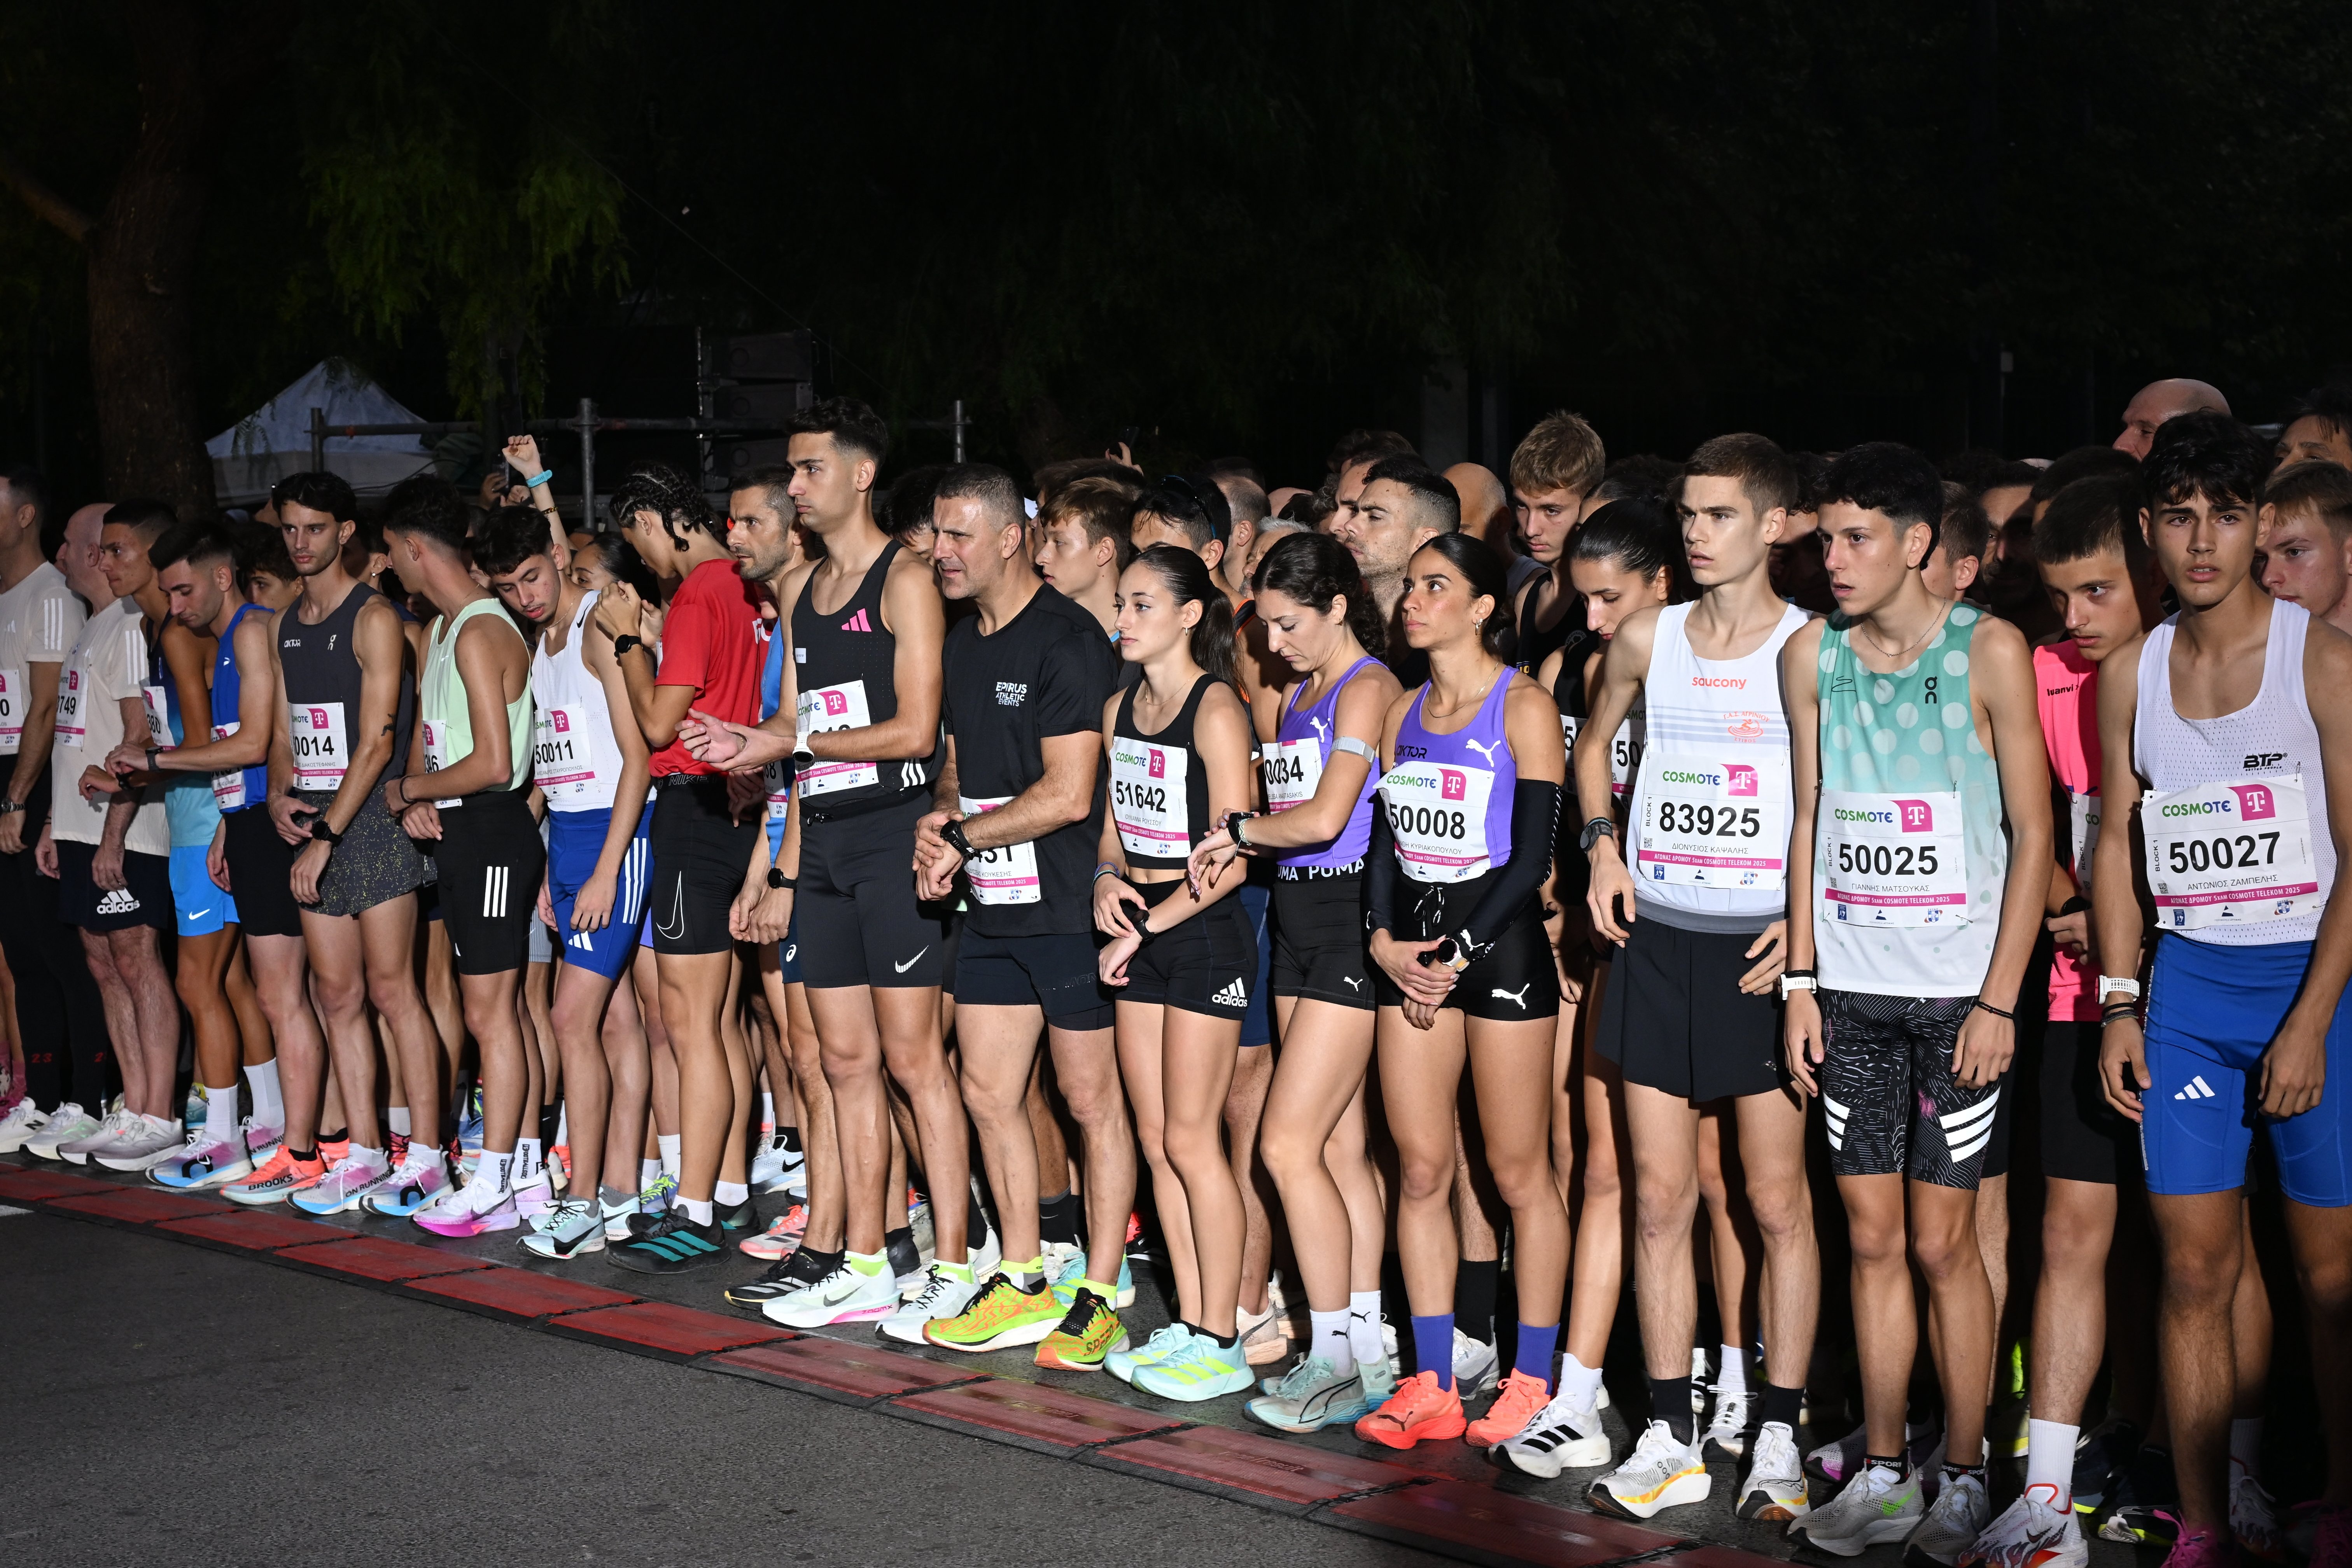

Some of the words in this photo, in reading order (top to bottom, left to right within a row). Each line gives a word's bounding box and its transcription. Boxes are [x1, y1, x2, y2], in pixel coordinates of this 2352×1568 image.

[996, 682, 1027, 694] EPIRUS
[1692, 677, 1746, 690] saucony
[2047, 684, 2074, 696] luanvi
[996, 692, 1025, 701] ATHLETIC
[998, 698, 1019, 707] EVENTS
[1741, 711, 1770, 722] ΑΓΡΙΝΙΟΥ
[535, 720, 552, 730] SMOTE
[293, 736, 334, 756] 0014
[536, 739, 574, 765] 50011
[1115, 752, 1146, 767] COSMOTE
[1387, 775, 1437, 789] COSMOTE
[1662, 771, 1720, 786] COSMOTE
[1116, 780, 1166, 813] 51642
[1835, 808, 1893, 823] COSMOTE
[2162, 800, 2231, 817] COSMOTE
[1142, 818, 1162, 826] ΡΟΥΣΣΟΥ
[1389, 802, 1465, 840] 50008
[1660, 802, 1760, 838] 83925
[1150, 830, 1165, 838] TELEKOM
[1410, 842, 1462, 855] ΚΥΡΙΑΚΟΠΟΥΛΟΥ
[1672, 843, 1708, 852] ΔΙΟΝΥΣΙΟΣ
[2170, 831, 2280, 874] 50027
[1839, 843, 1938, 875] 50025
[1278, 866, 1299, 881] UMA
[1309, 857, 1364, 880] PUMA
[1852, 884, 1880, 892] ΓΙΑΝΝΗΣ
[2188, 880, 2228, 891] ΑΝΤΩΝΙΟΣ
[2231, 874, 2278, 886] ΖΑΜΠΕΛΗΣ
[1838, 892, 1850, 901] ΑΓΩΝΑΣ
[2189, 895, 2212, 904] ΔΡΟΜΟΥ
[2228, 891, 2256, 900] COSMOTE
[2256, 888, 2284, 897] TELEKOM
[96, 899, 140, 914] adidas
[1212, 994, 1248, 1007] adidas
[257, 1132, 284, 1151] RUNNI
[248, 1174, 293, 1191] BROOKS
[345, 1186, 358, 1198] ON
[359, 1170, 391, 1190] RUNNING
